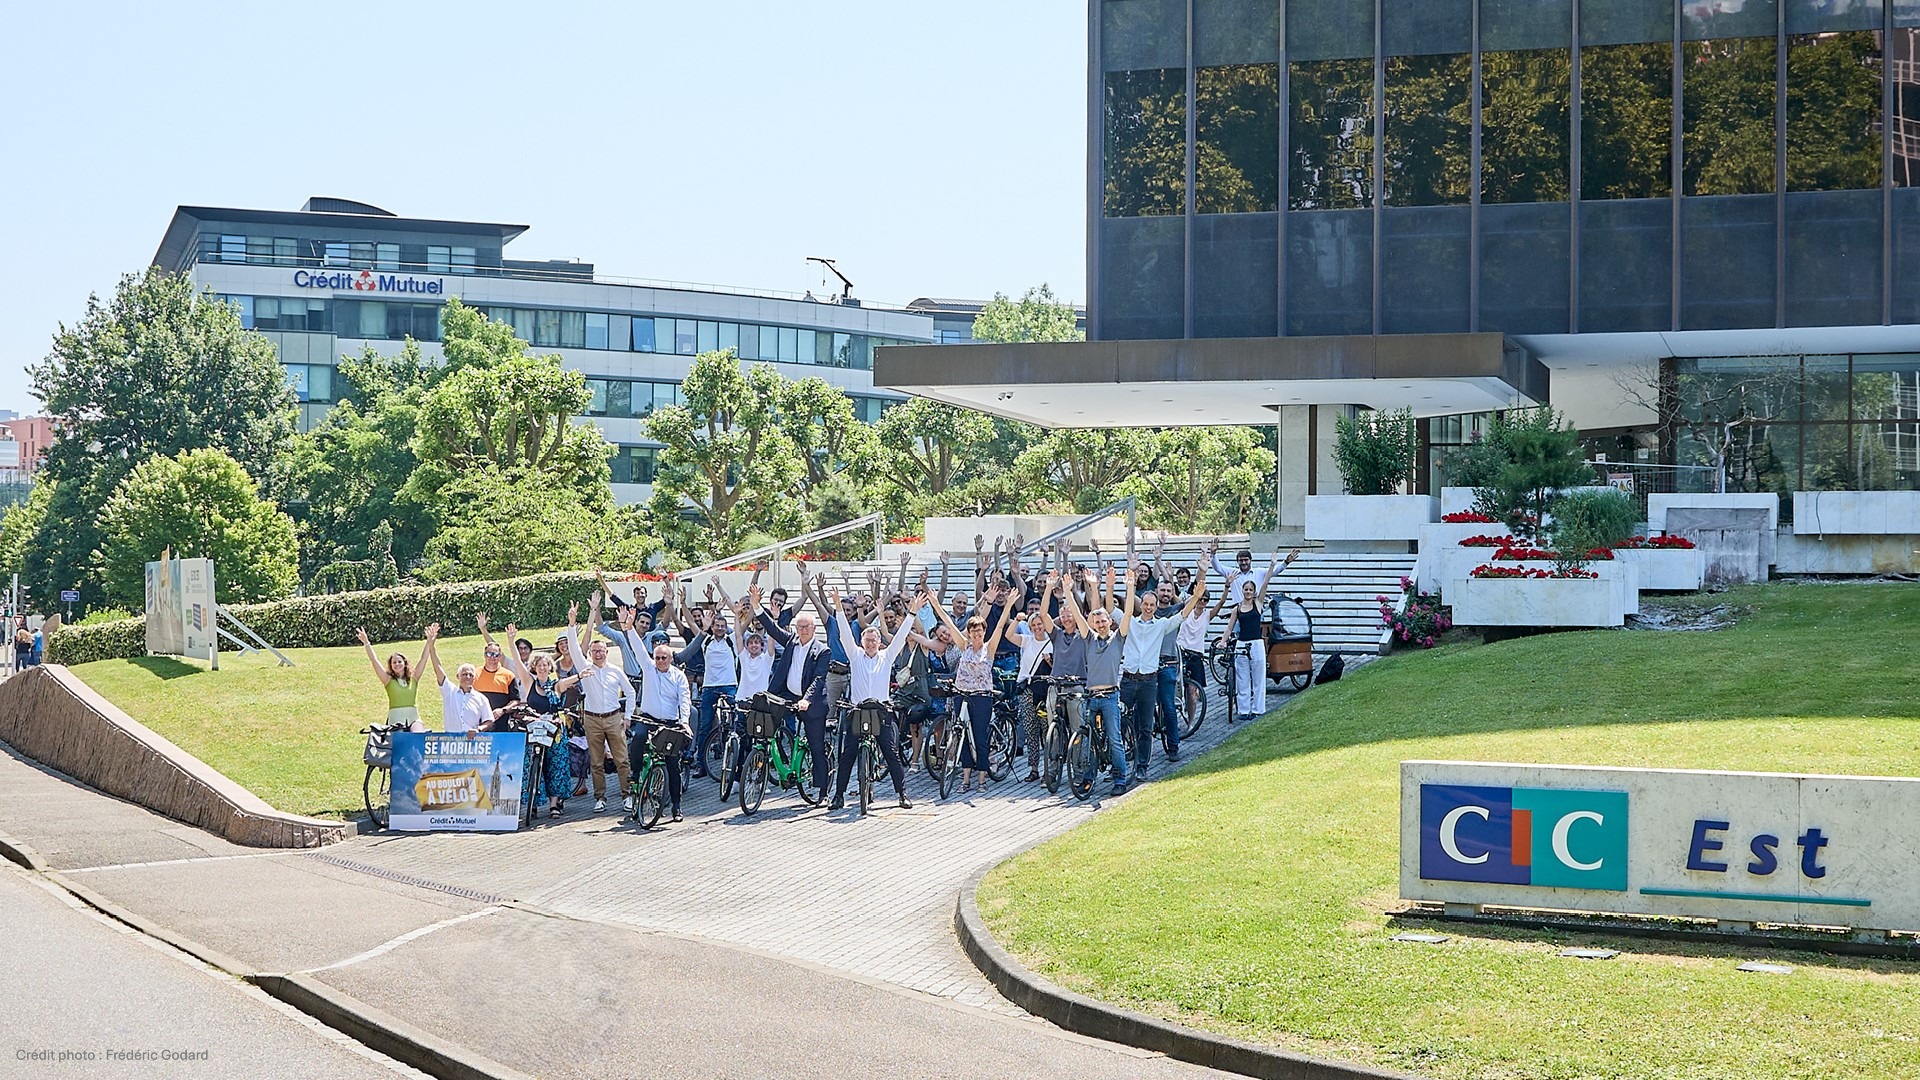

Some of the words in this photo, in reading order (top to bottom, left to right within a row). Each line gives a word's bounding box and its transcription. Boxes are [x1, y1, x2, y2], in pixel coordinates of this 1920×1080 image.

[294, 270, 353, 290] Crédit
[379, 275, 443, 294] Mutuel
[424, 742, 438, 755] SE
[440, 741, 492, 755] MOBILISE
[426, 780, 436, 789] AU
[437, 777, 466, 789] BOULOT
[438, 786, 469, 804] VÉLO
[1439, 805, 1604, 870] CIC
[1686, 819, 1829, 878] Est
